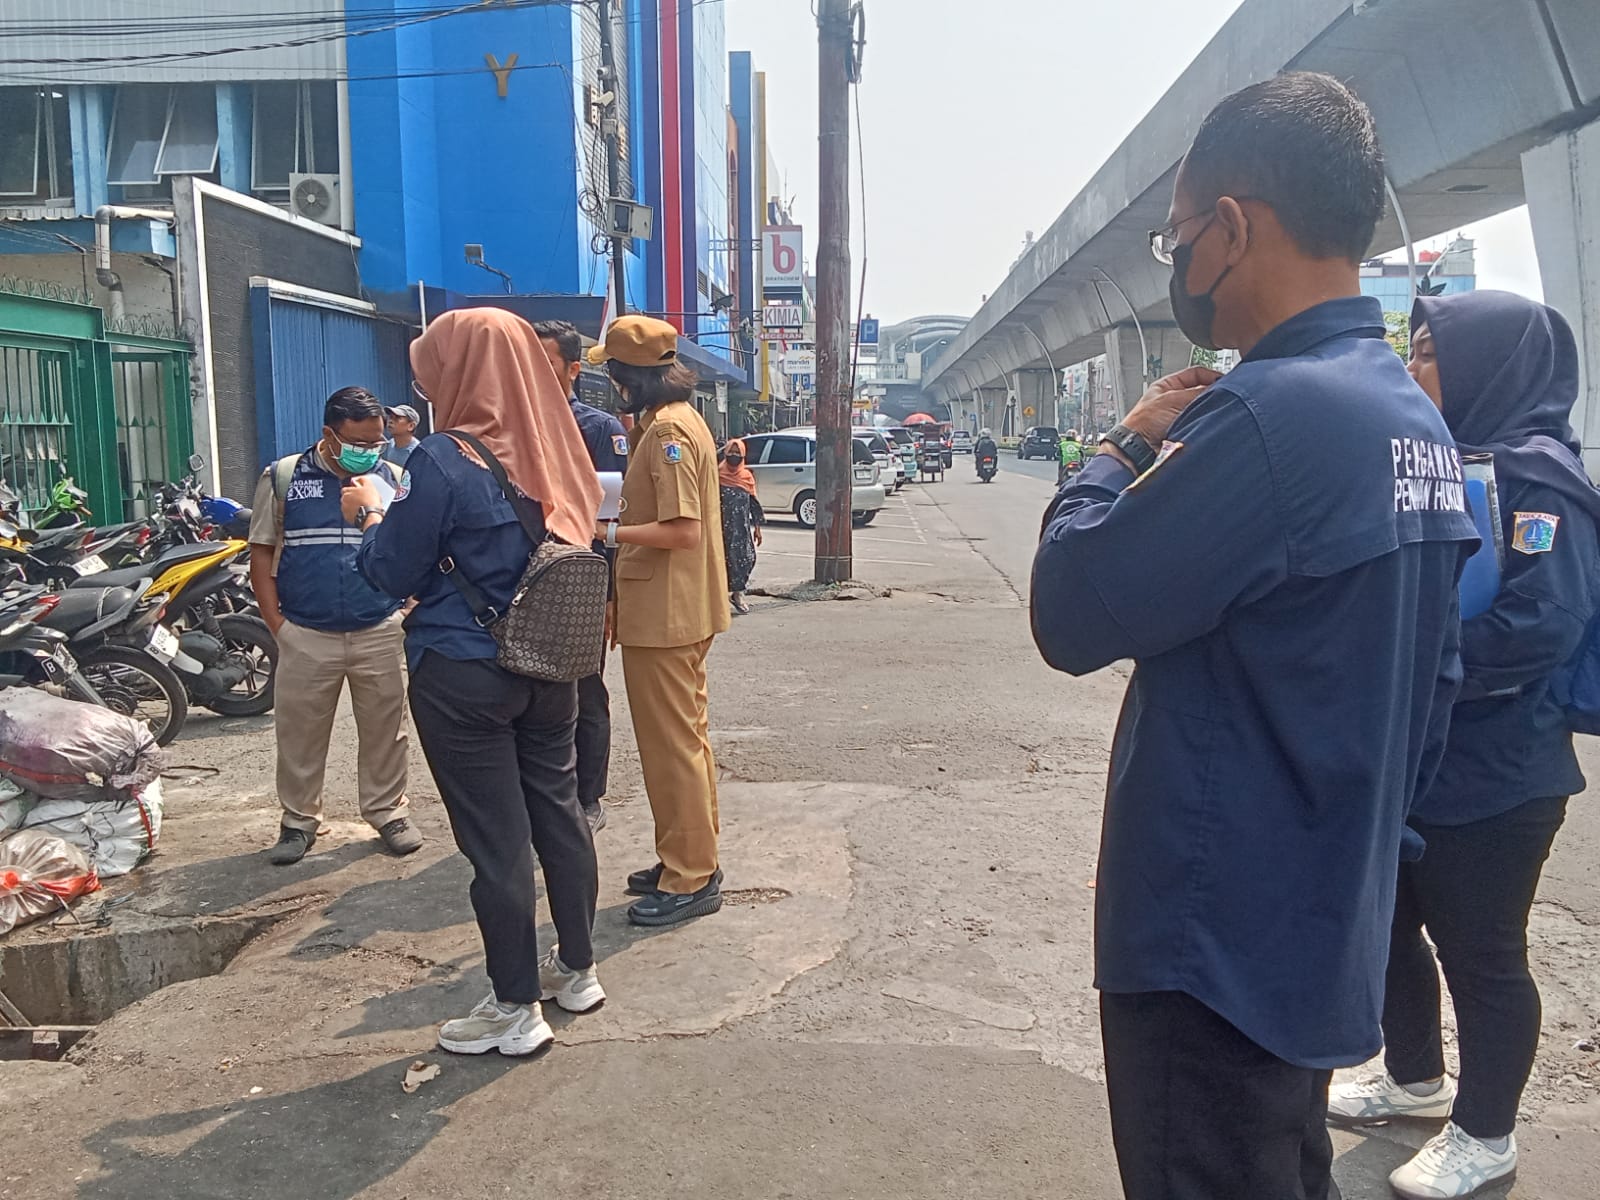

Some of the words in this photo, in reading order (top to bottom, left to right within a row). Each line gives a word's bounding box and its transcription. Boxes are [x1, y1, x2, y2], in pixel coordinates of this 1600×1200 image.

[484, 53, 519, 97] Y
[764, 308, 800, 325] KIMIA
[864, 322, 875, 341] P
[1391, 437, 1462, 482] PENGAWAS
[46, 661, 57, 673] B
